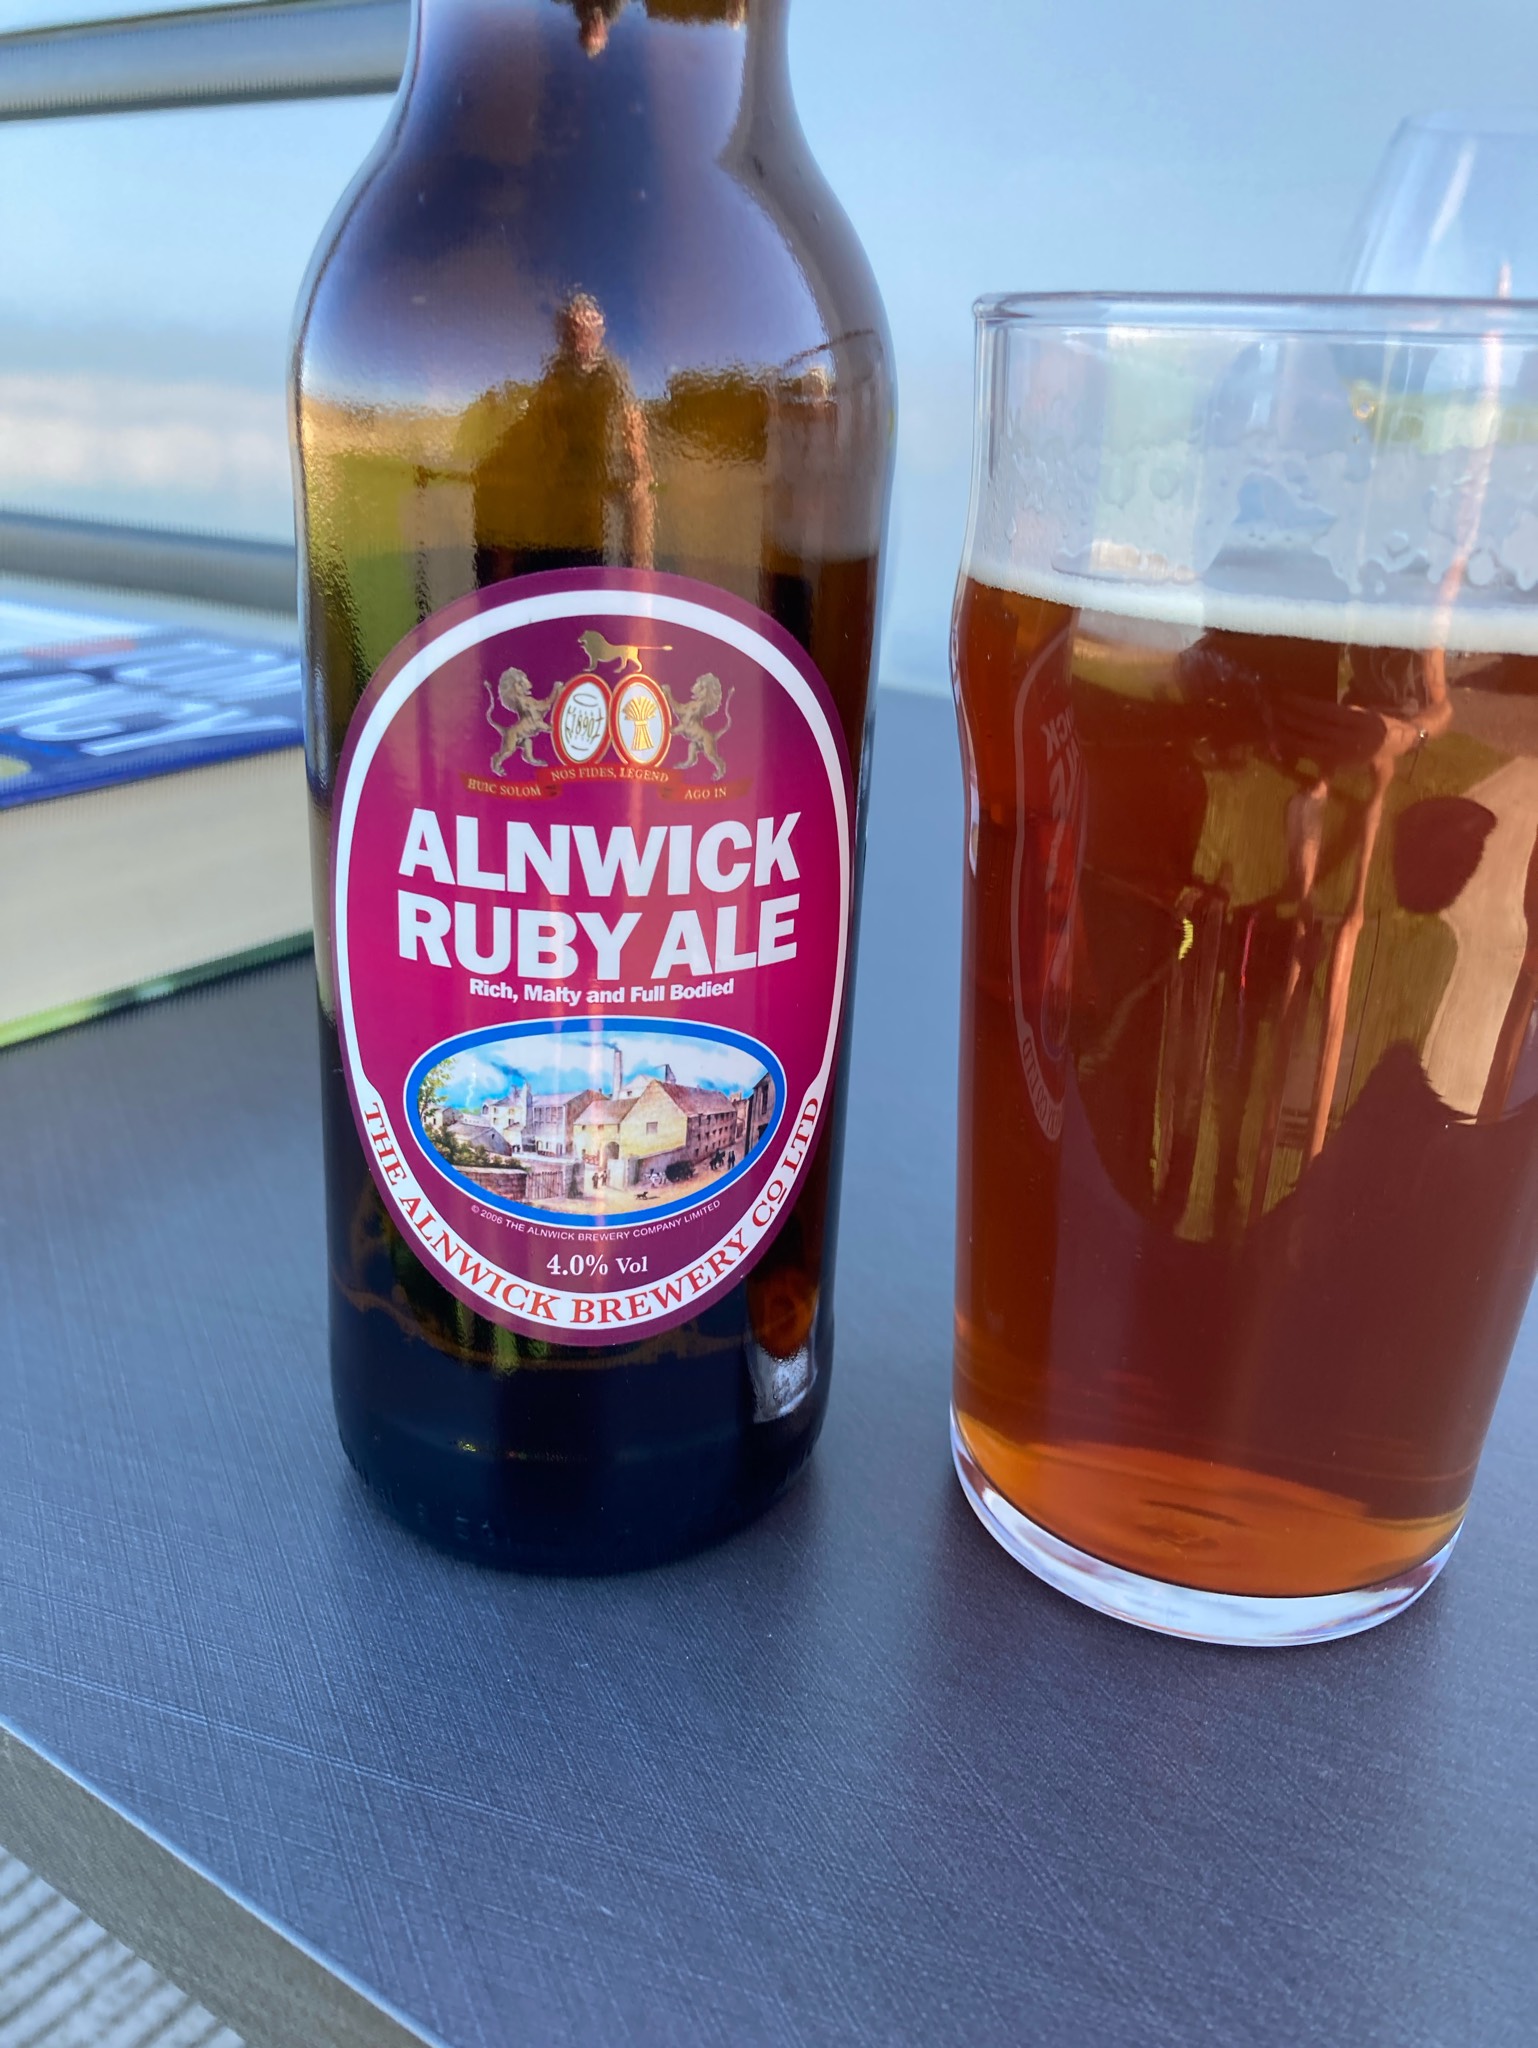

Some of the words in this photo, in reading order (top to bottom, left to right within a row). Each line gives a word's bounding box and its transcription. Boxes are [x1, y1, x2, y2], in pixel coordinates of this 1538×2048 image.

[468, 778, 496, 794] HUIC
[500, 784, 541, 797] SOLOM
[551, 768, 576, 781] NOS
[579, 767, 617, 779] FIDES,
[620, 767, 669, 783] LEGEND
[684, 789, 710, 800] AGO
[714, 787, 727, 798] IN
[398, 807, 801, 897] ALNWICK
[397, 889, 643, 981] RUBY
[650, 894, 800, 979] ALE
[469, 978, 519, 1003] Rich,
[524, 984, 582, 1006] Malty
[586, 986, 625, 1004] and
[630, 986, 664, 1003] Full
[670, 978, 735, 1000] Bodied
[364, 1101, 408, 1186] THE
[399, 1196, 561, 1321] ALNWICK
[569, 1227, 749, 1324] BREWERY
[752, 1179, 787, 1227] CO
[781, 1097, 819, 1174] LTD
[480, 1209, 503, 1224] 2006
[505, 1219, 525, 1233] THE
[527, 1228, 575, 1241] ALNWICK
[578, 1231, 630, 1241] BREWERY
[632, 1217, 682, 1238] COMPANY
[684, 1199, 721, 1223] LIMITED
[546, 1253, 609, 1276] 4.0%
[615, 1255, 648, 1274] Vol
